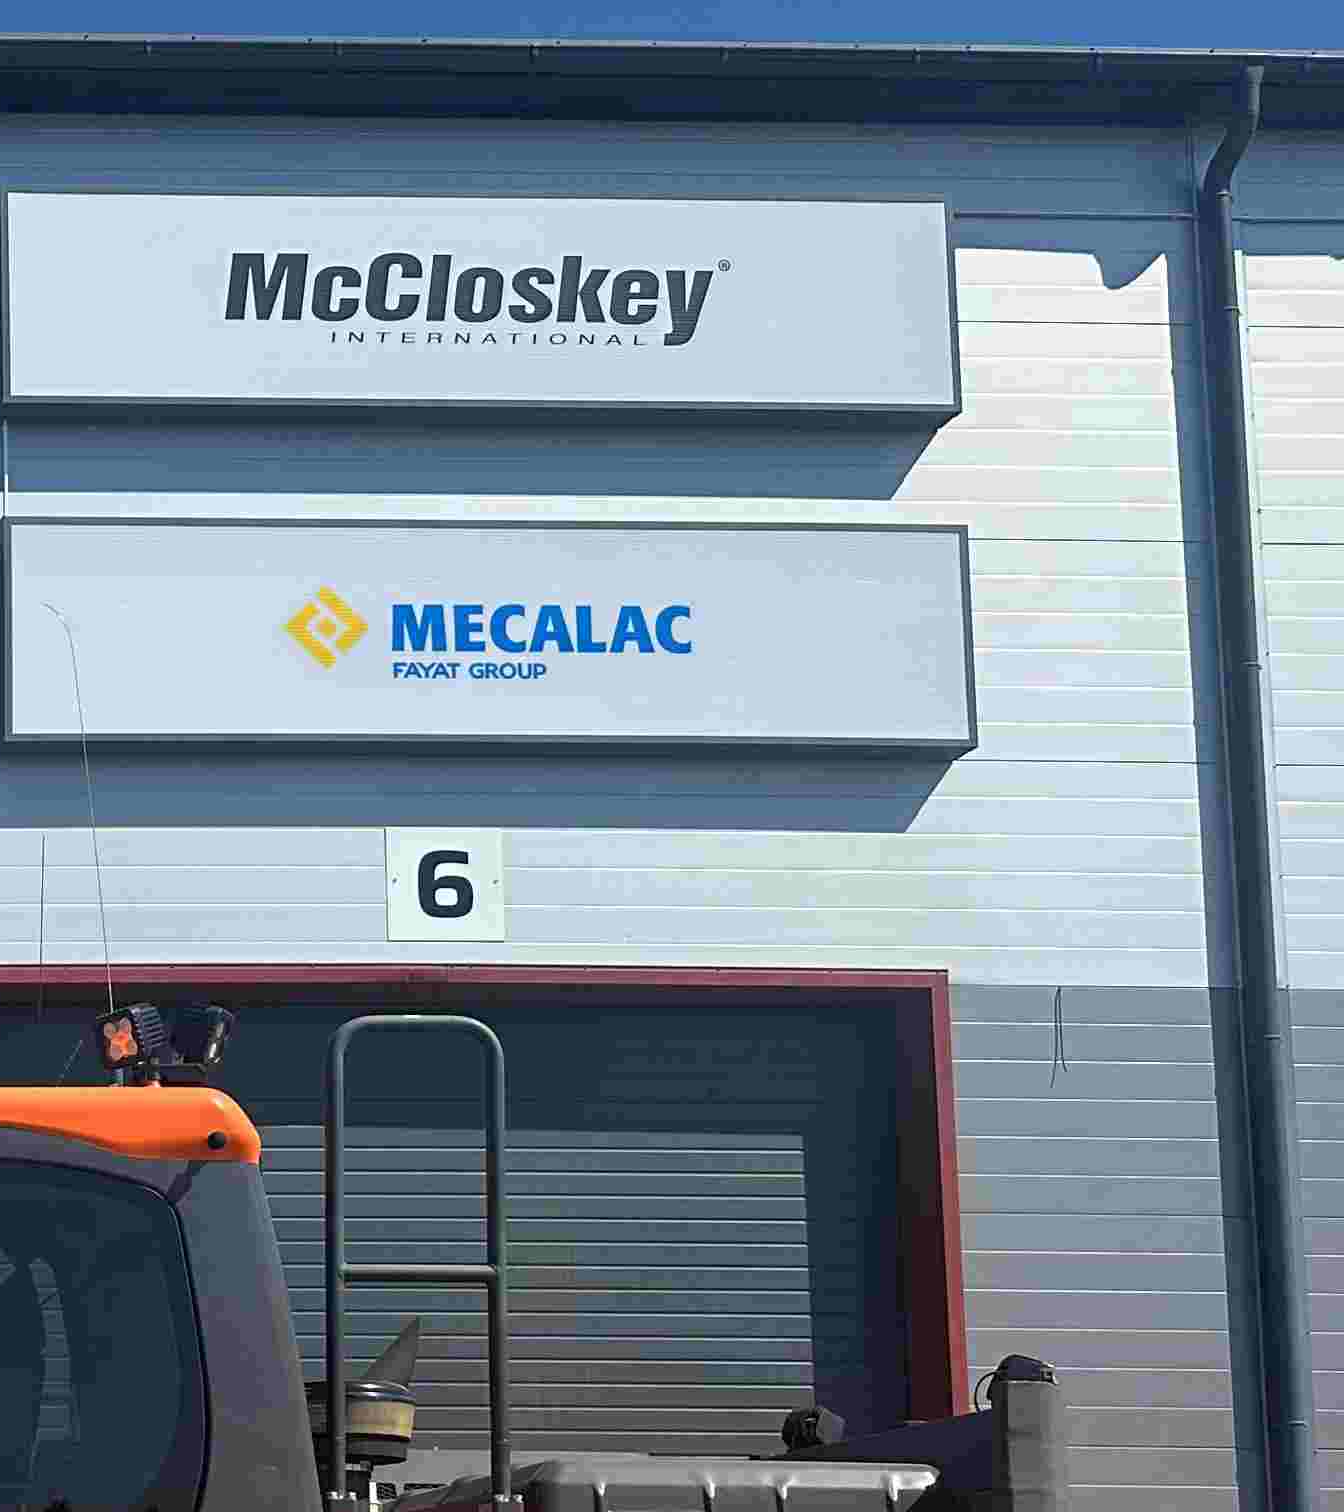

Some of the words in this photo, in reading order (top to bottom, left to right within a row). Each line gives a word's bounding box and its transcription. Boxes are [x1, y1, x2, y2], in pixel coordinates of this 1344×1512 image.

[224, 252, 714, 346] McCloskey
[330, 331, 647, 346] INTERNATIONAL
[391, 603, 694, 655] MECALAC
[392, 661, 461, 680] FAYAT
[468, 661, 548, 681] GROUP
[417, 850, 475, 919] 6
